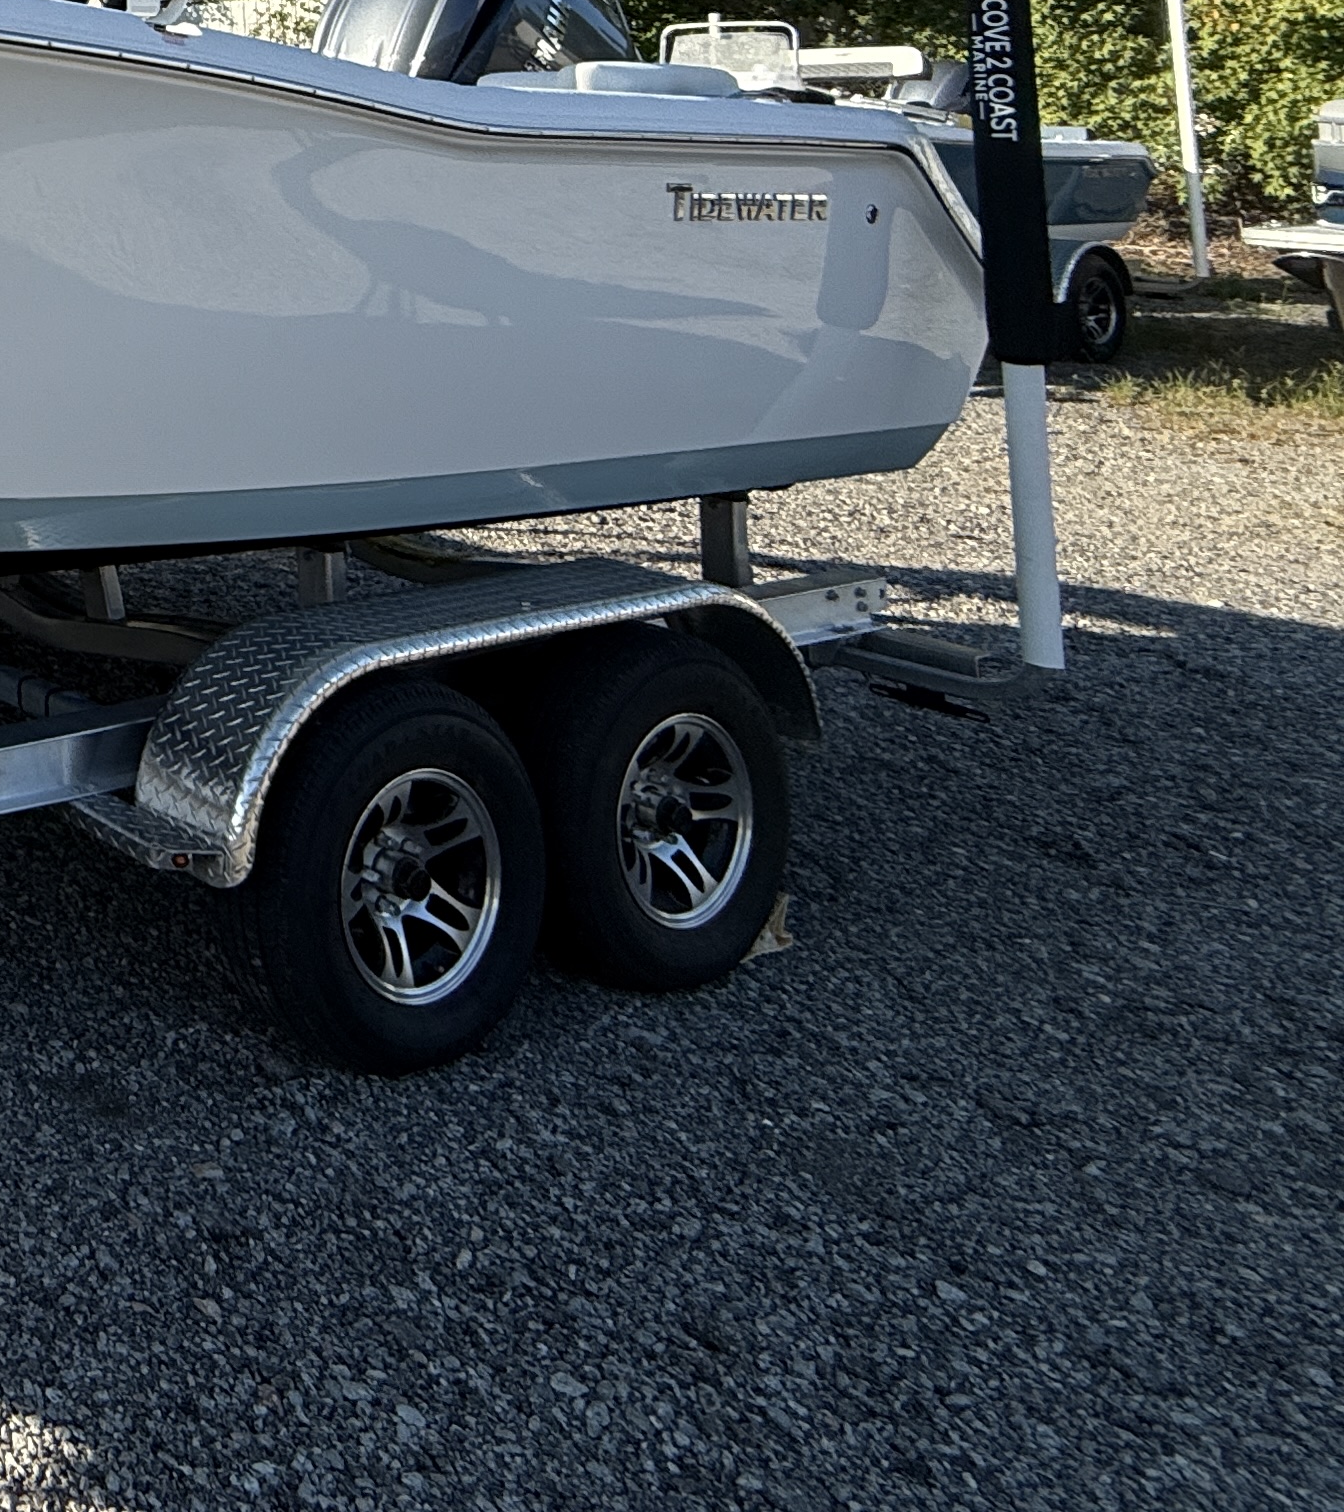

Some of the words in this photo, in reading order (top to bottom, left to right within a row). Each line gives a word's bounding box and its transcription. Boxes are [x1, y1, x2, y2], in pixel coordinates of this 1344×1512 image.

[971, 35, 988, 101] MARINE
[988, 57, 1012, 70] 2
[987, 73, 1018, 142] COAST
[666, 182, 828, 222] TIDEWATER
